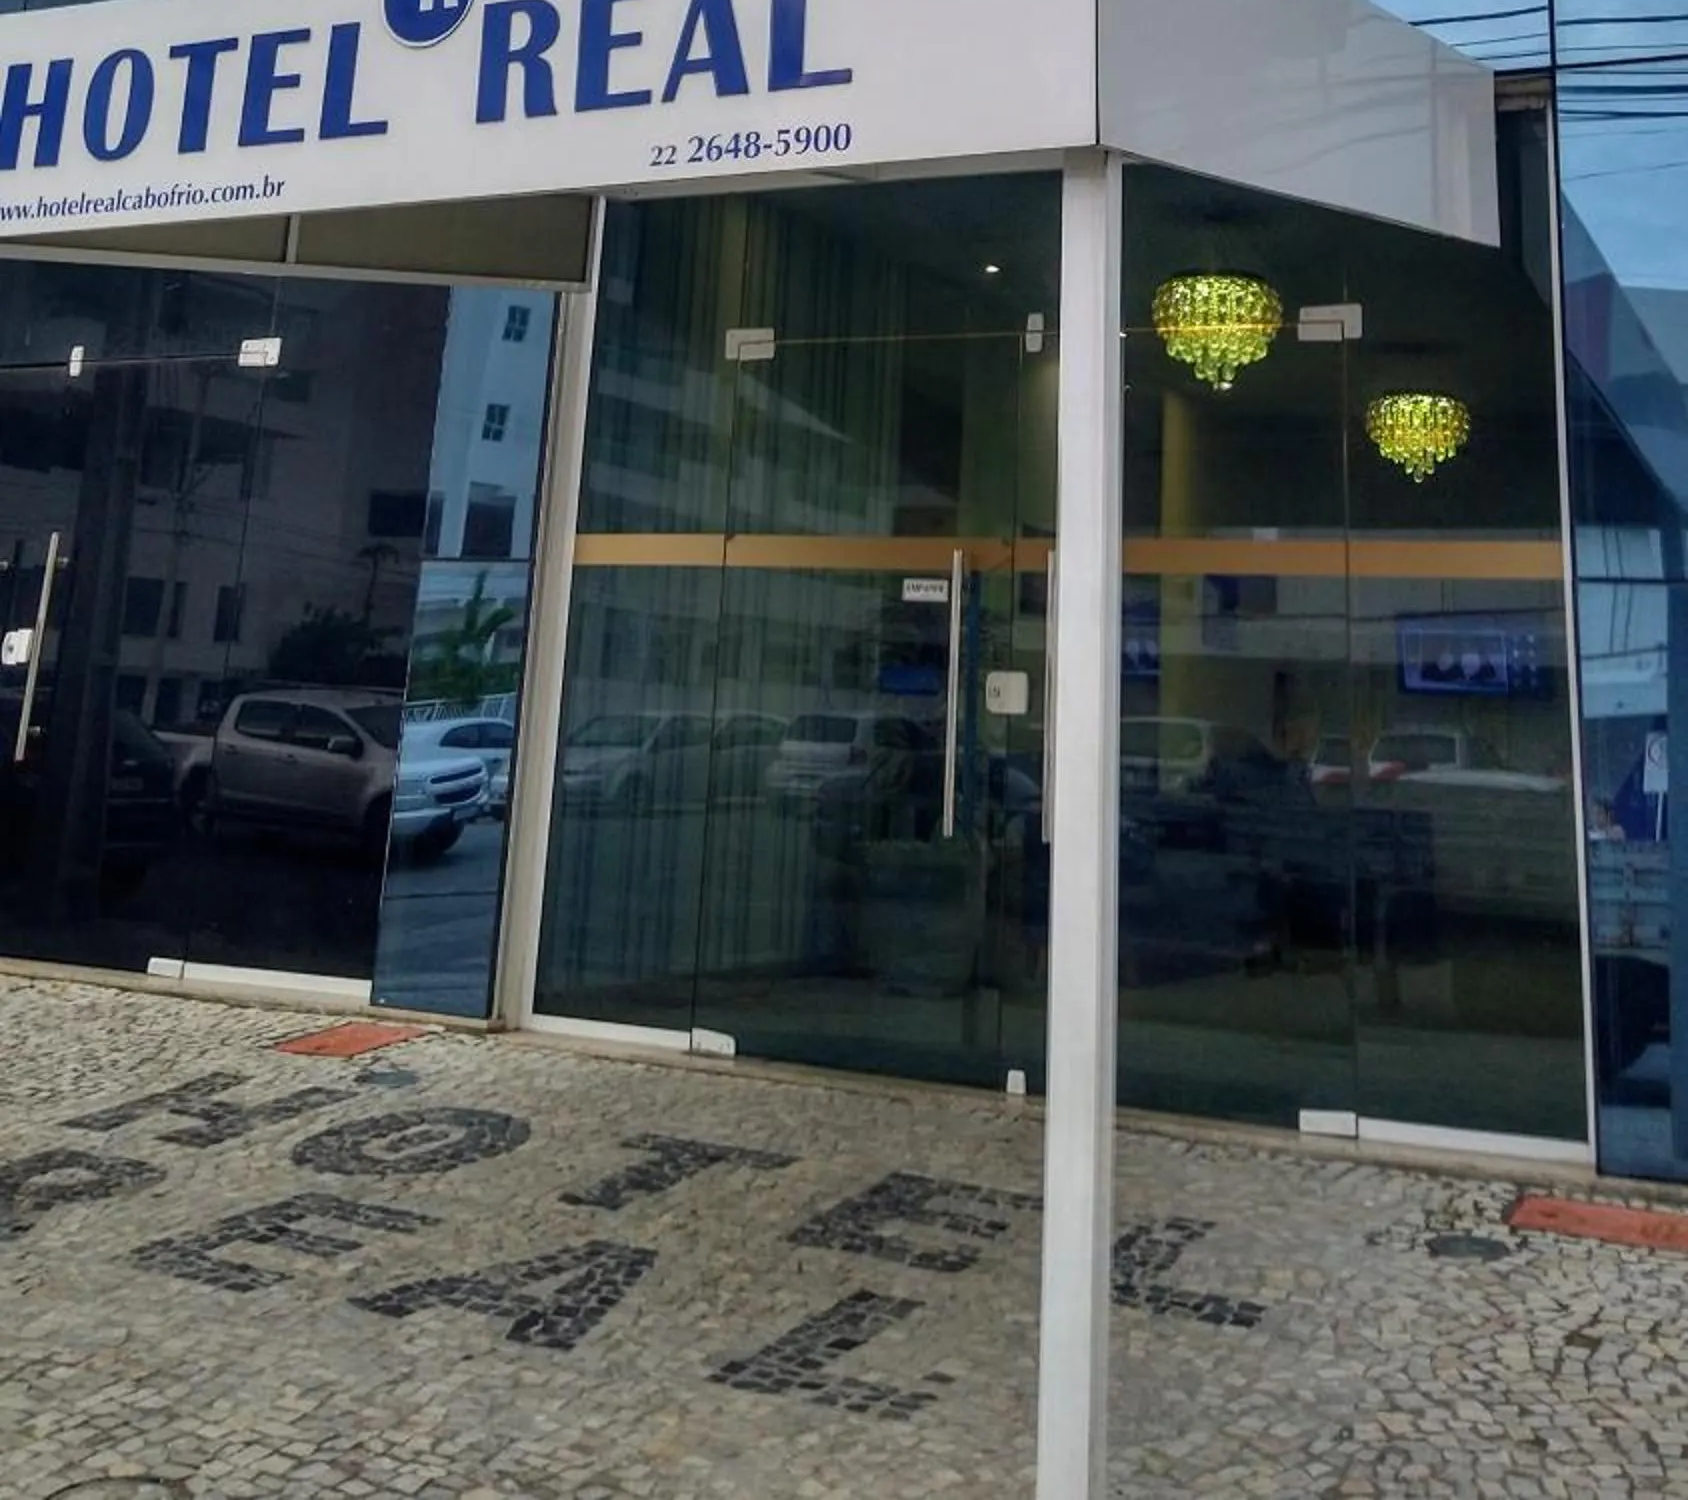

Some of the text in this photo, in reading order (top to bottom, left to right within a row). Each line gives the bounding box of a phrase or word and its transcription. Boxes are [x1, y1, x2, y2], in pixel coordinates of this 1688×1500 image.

[0, 22, 388, 171] HOTEL
[649, 123, 852, 167] 22 2648-5900
[58, 1071, 1267, 1329] HOTEL
